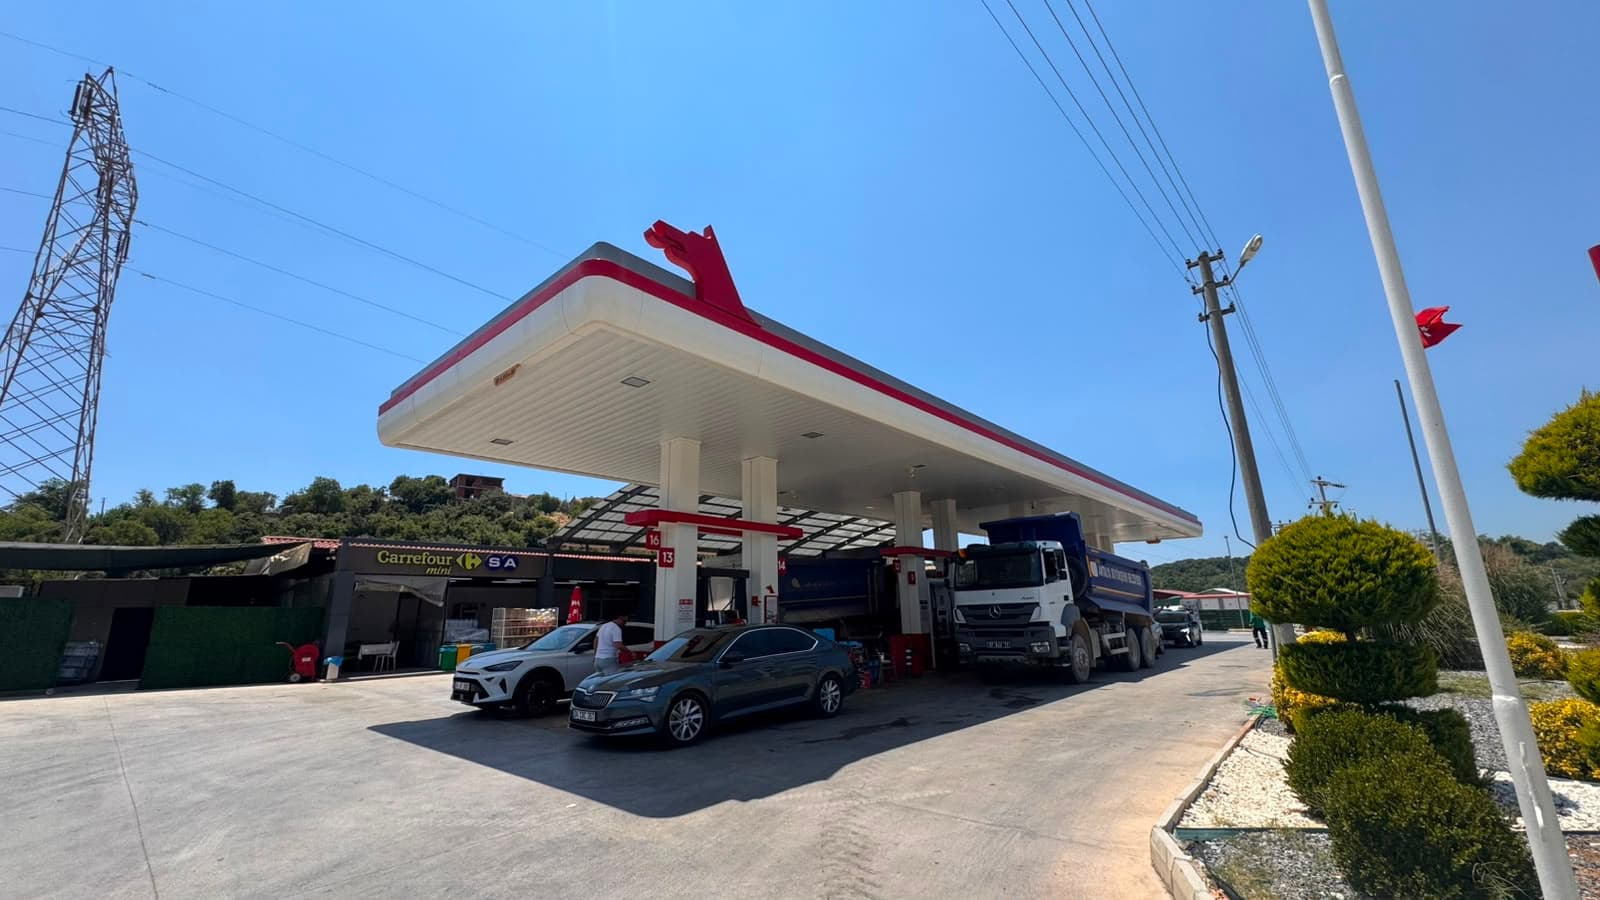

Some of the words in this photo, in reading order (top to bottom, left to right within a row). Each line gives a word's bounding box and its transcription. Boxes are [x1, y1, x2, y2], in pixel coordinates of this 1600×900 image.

[649, 534, 660, 546] 16
[377, 550, 452, 565] Carrefour
[488, 557, 517, 568] SA
[662, 552, 673, 563] 13
[778, 560, 786, 571] 14
[425, 567, 451, 576] mini
